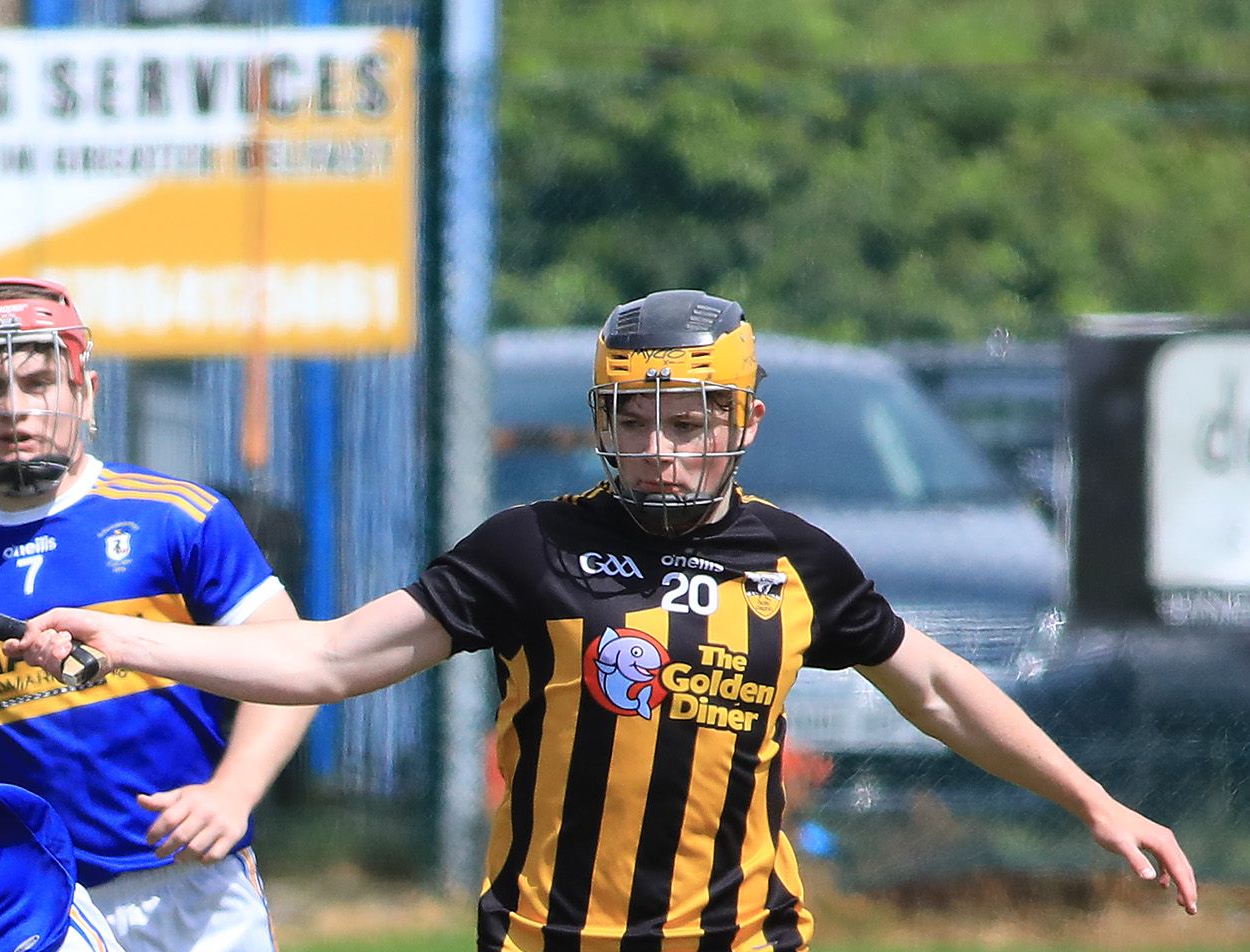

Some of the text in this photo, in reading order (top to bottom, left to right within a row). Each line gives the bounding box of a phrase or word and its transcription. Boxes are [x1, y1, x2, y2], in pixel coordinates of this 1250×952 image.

[49, 54, 389, 119] SERVICES
[15, 554, 44, 596] 7
[661, 571, 719, 616] 20
[698, 644, 748, 672] The
[661, 662, 775, 706] Golden
[669, 692, 759, 732] Diner
